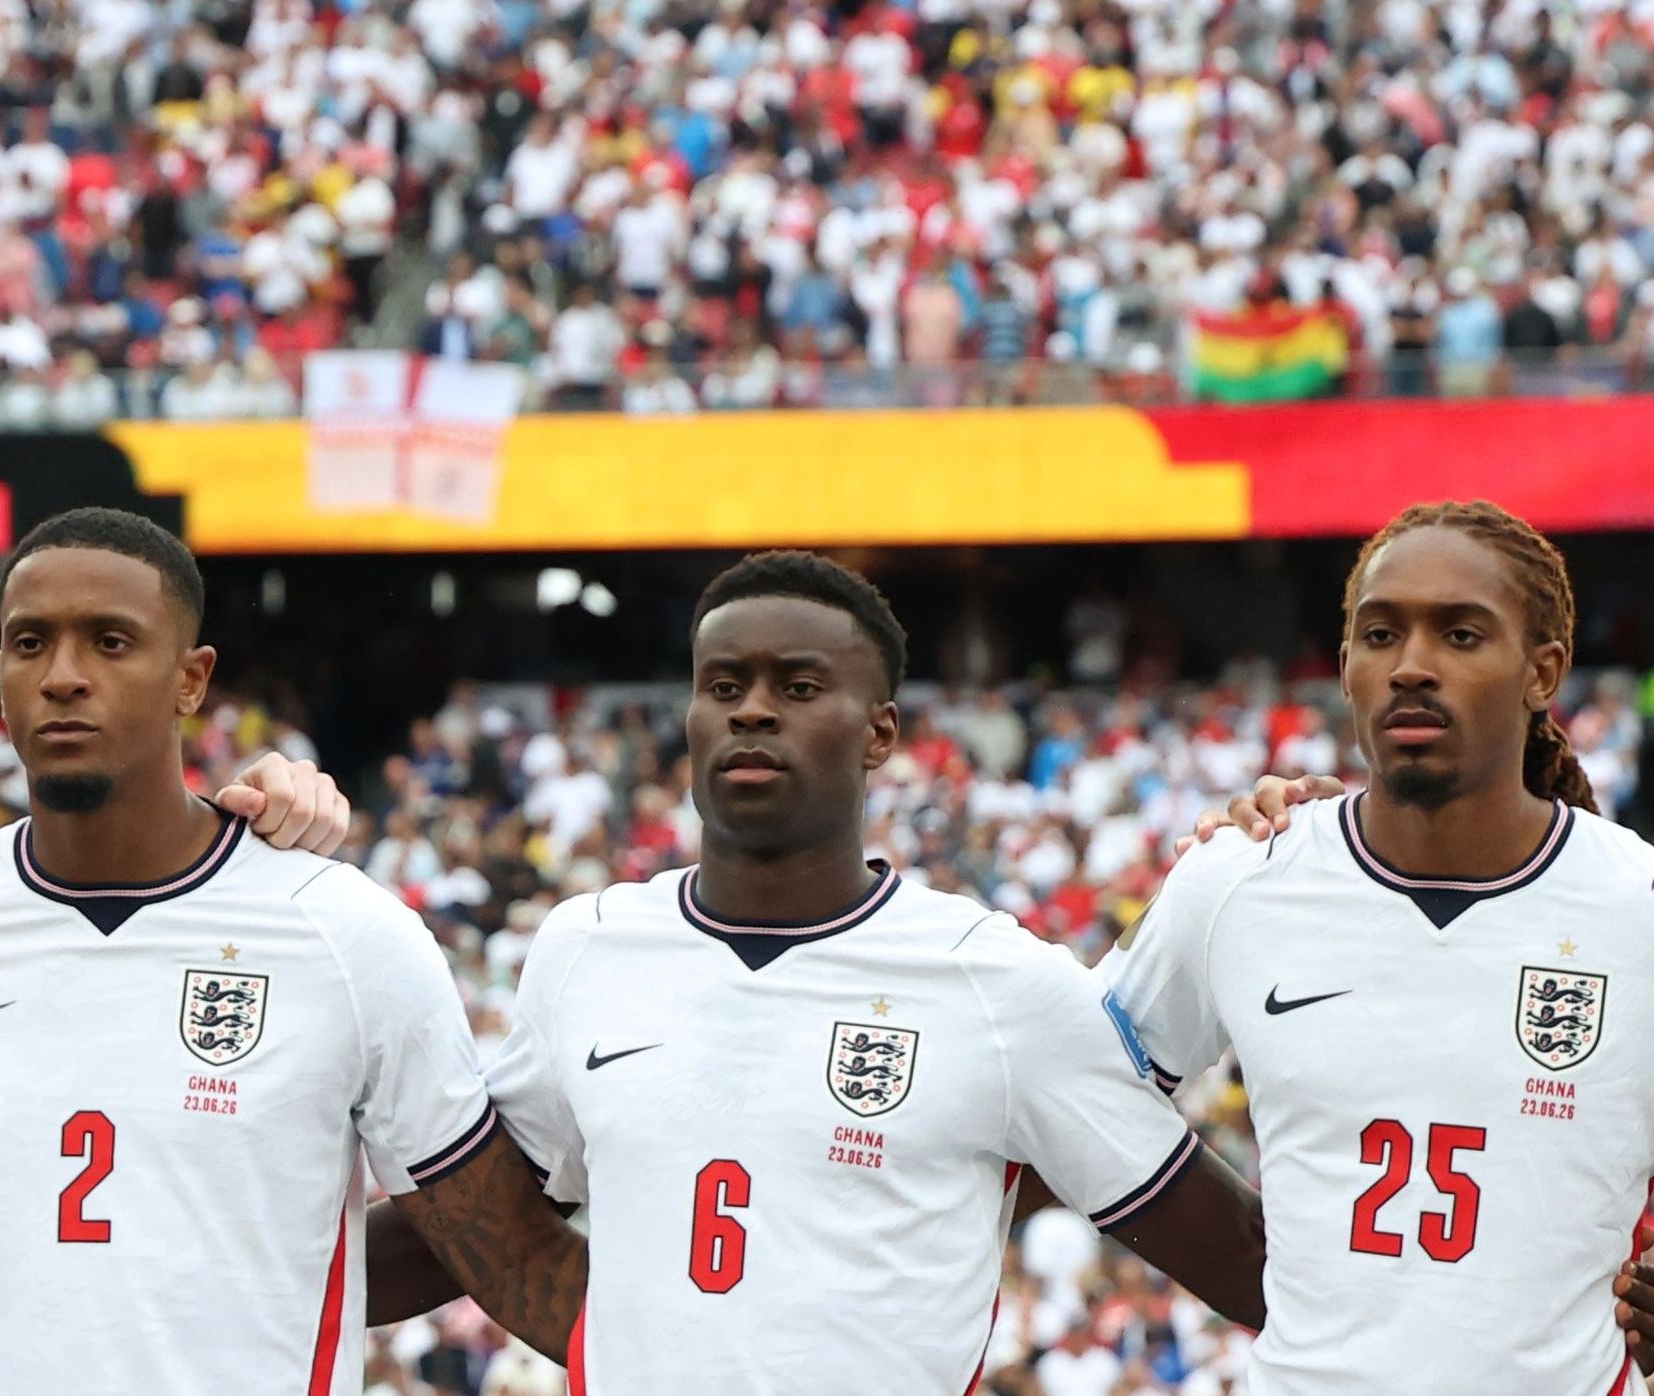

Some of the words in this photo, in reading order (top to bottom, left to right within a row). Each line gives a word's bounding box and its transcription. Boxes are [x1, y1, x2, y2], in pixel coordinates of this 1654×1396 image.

[188, 1075, 238, 1095] GHANA
[1524, 1077, 1576, 1099] GHANA
[183, 1095, 237, 1115] 23.06.26
[1520, 1097, 1575, 1120] 23.06.26
[833, 1126, 884, 1150] GHANA
[827, 1146, 883, 1169] 23.06.26
[57, 1110, 116, 1243] 2
[1349, 1118, 1488, 1264] 25
[688, 1158, 753, 1295] 6
